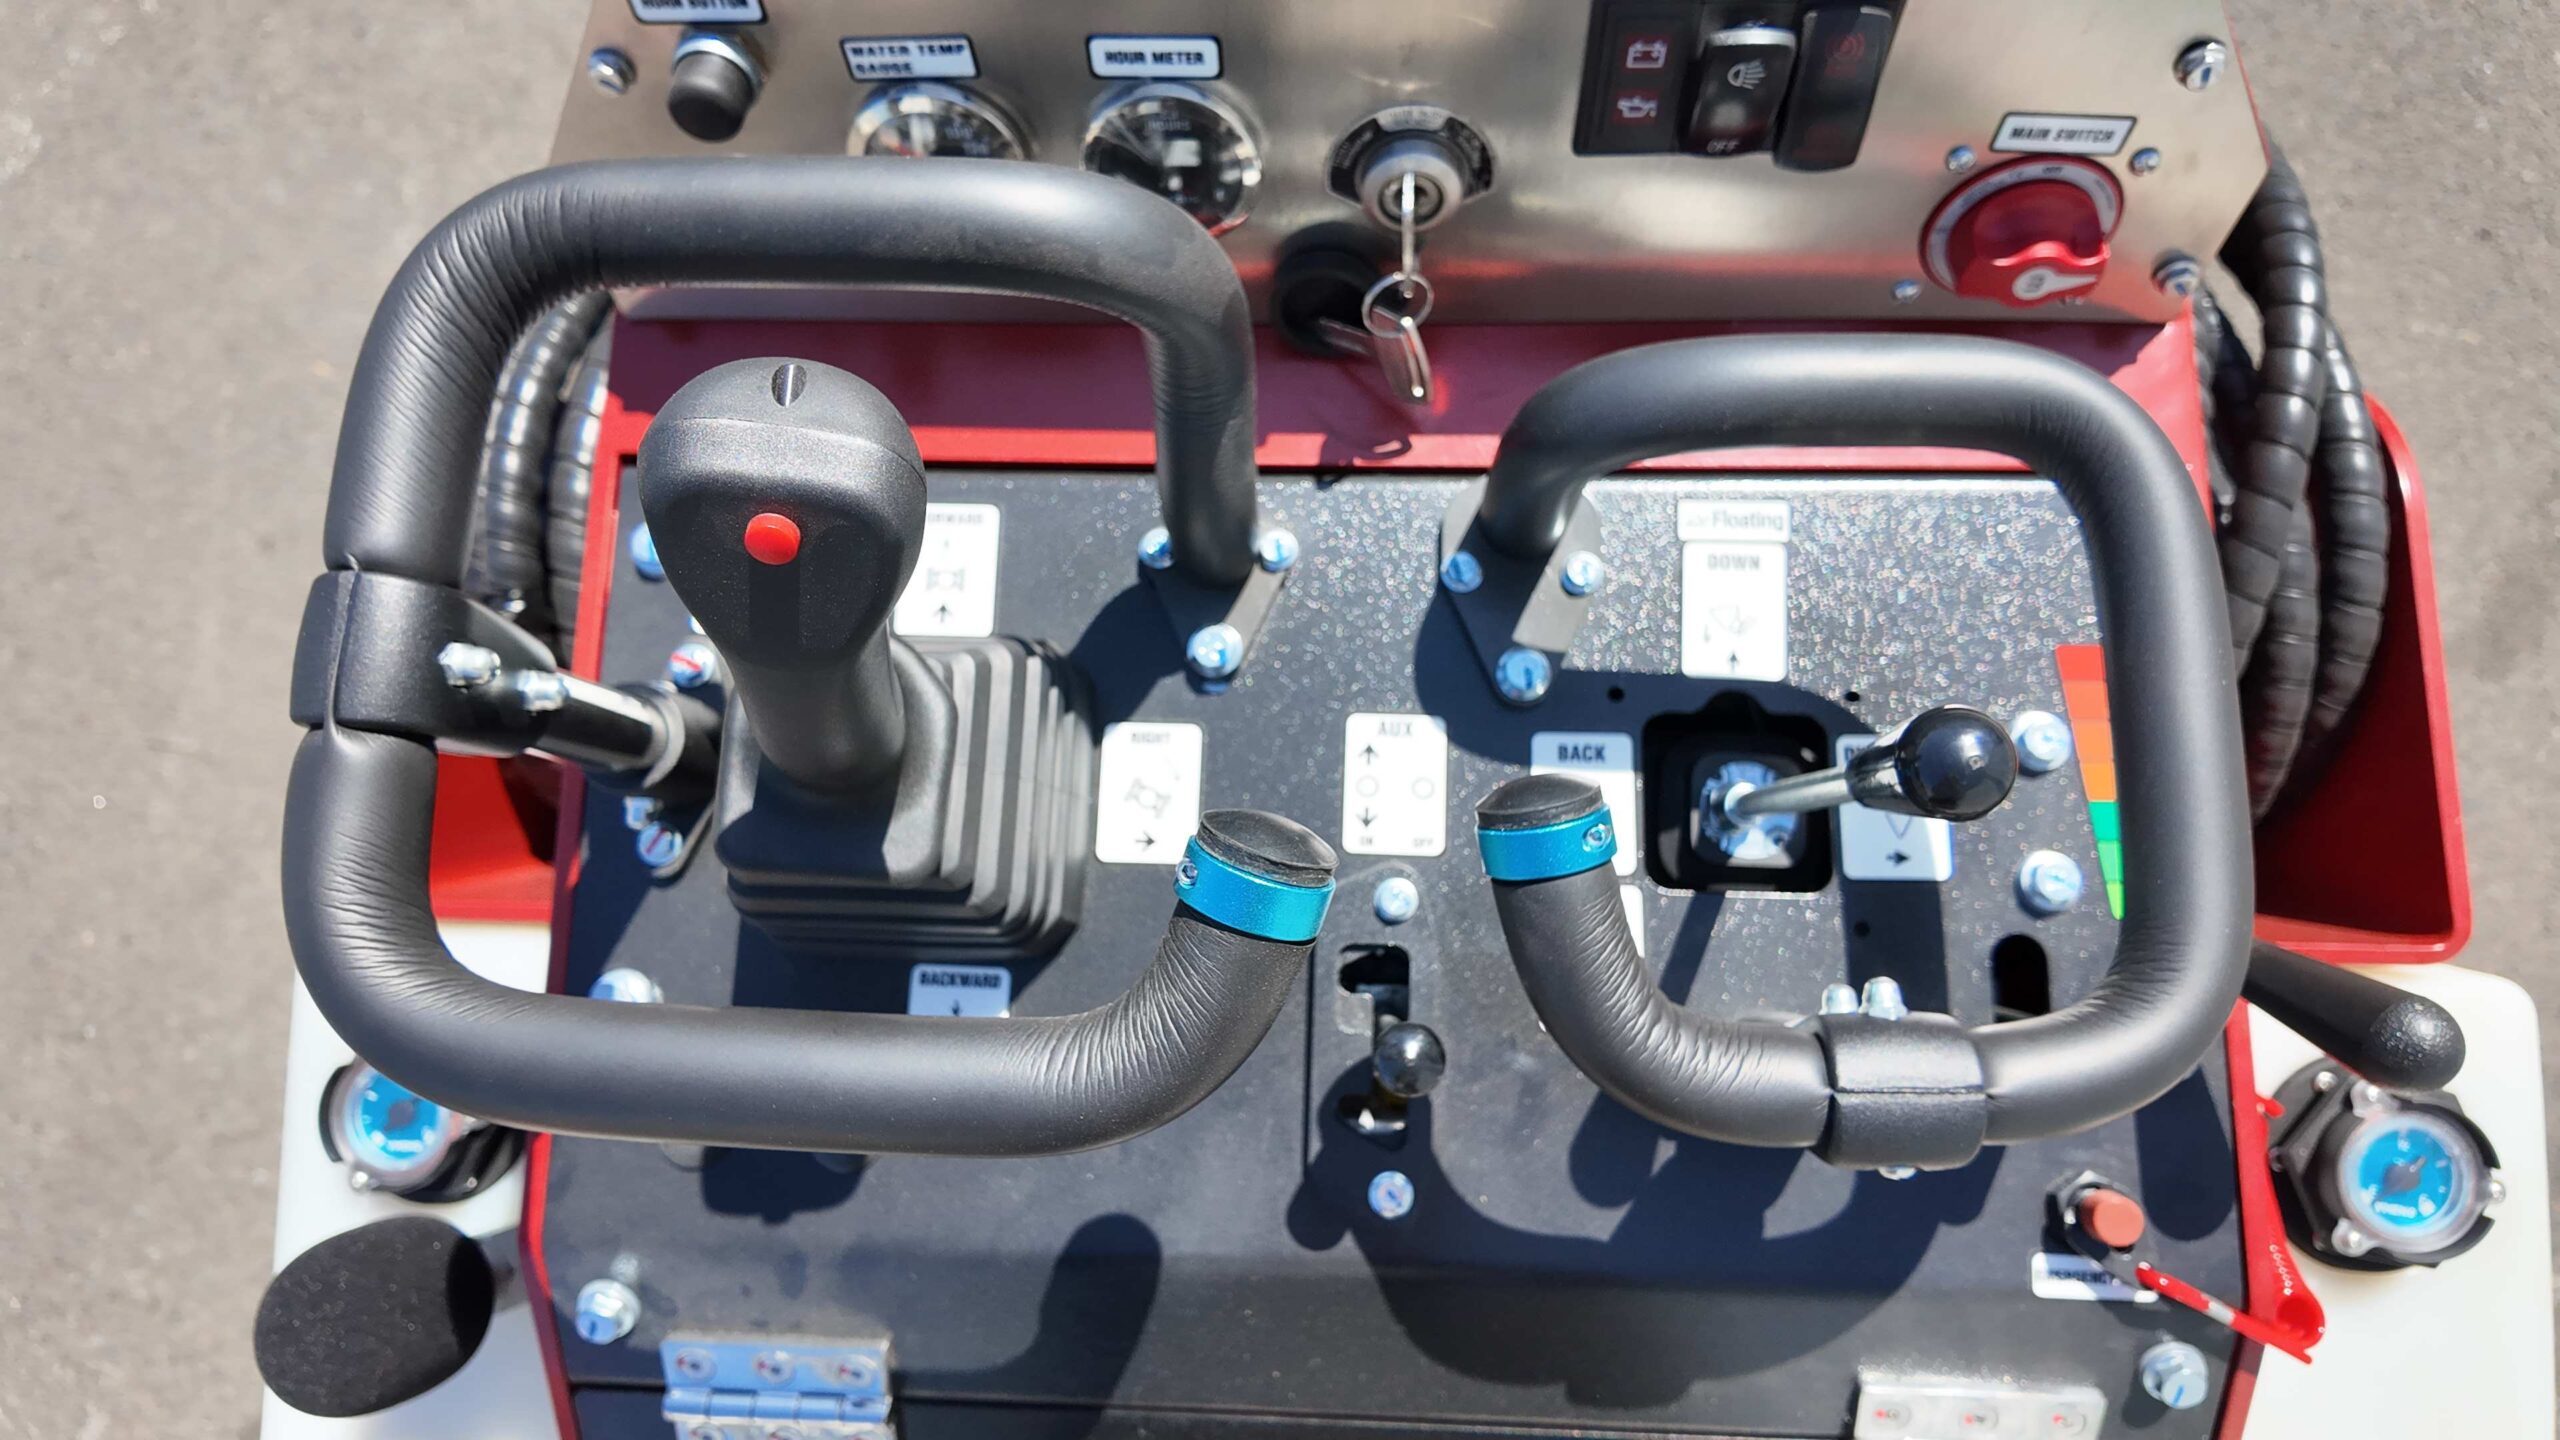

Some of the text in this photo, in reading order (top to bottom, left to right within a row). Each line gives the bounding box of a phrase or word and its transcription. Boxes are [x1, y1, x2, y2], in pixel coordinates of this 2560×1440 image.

[851, 44, 966, 57] WATER TEMP
[1104, 51, 1205, 65] HOUR METER
[2009, 127, 2116, 142] MAIN SWITCH
[927, 513, 985, 525] ORWARD
[1712, 509, 1783, 531] Floating
[1708, 554, 1761, 571] DOWN
[1378, 721, 1413, 737] AUX
[1131, 731, 1171, 744] RIGHT
[1558, 744, 1606, 762] BACK
[921, 971, 1002, 988] BACKWARD
